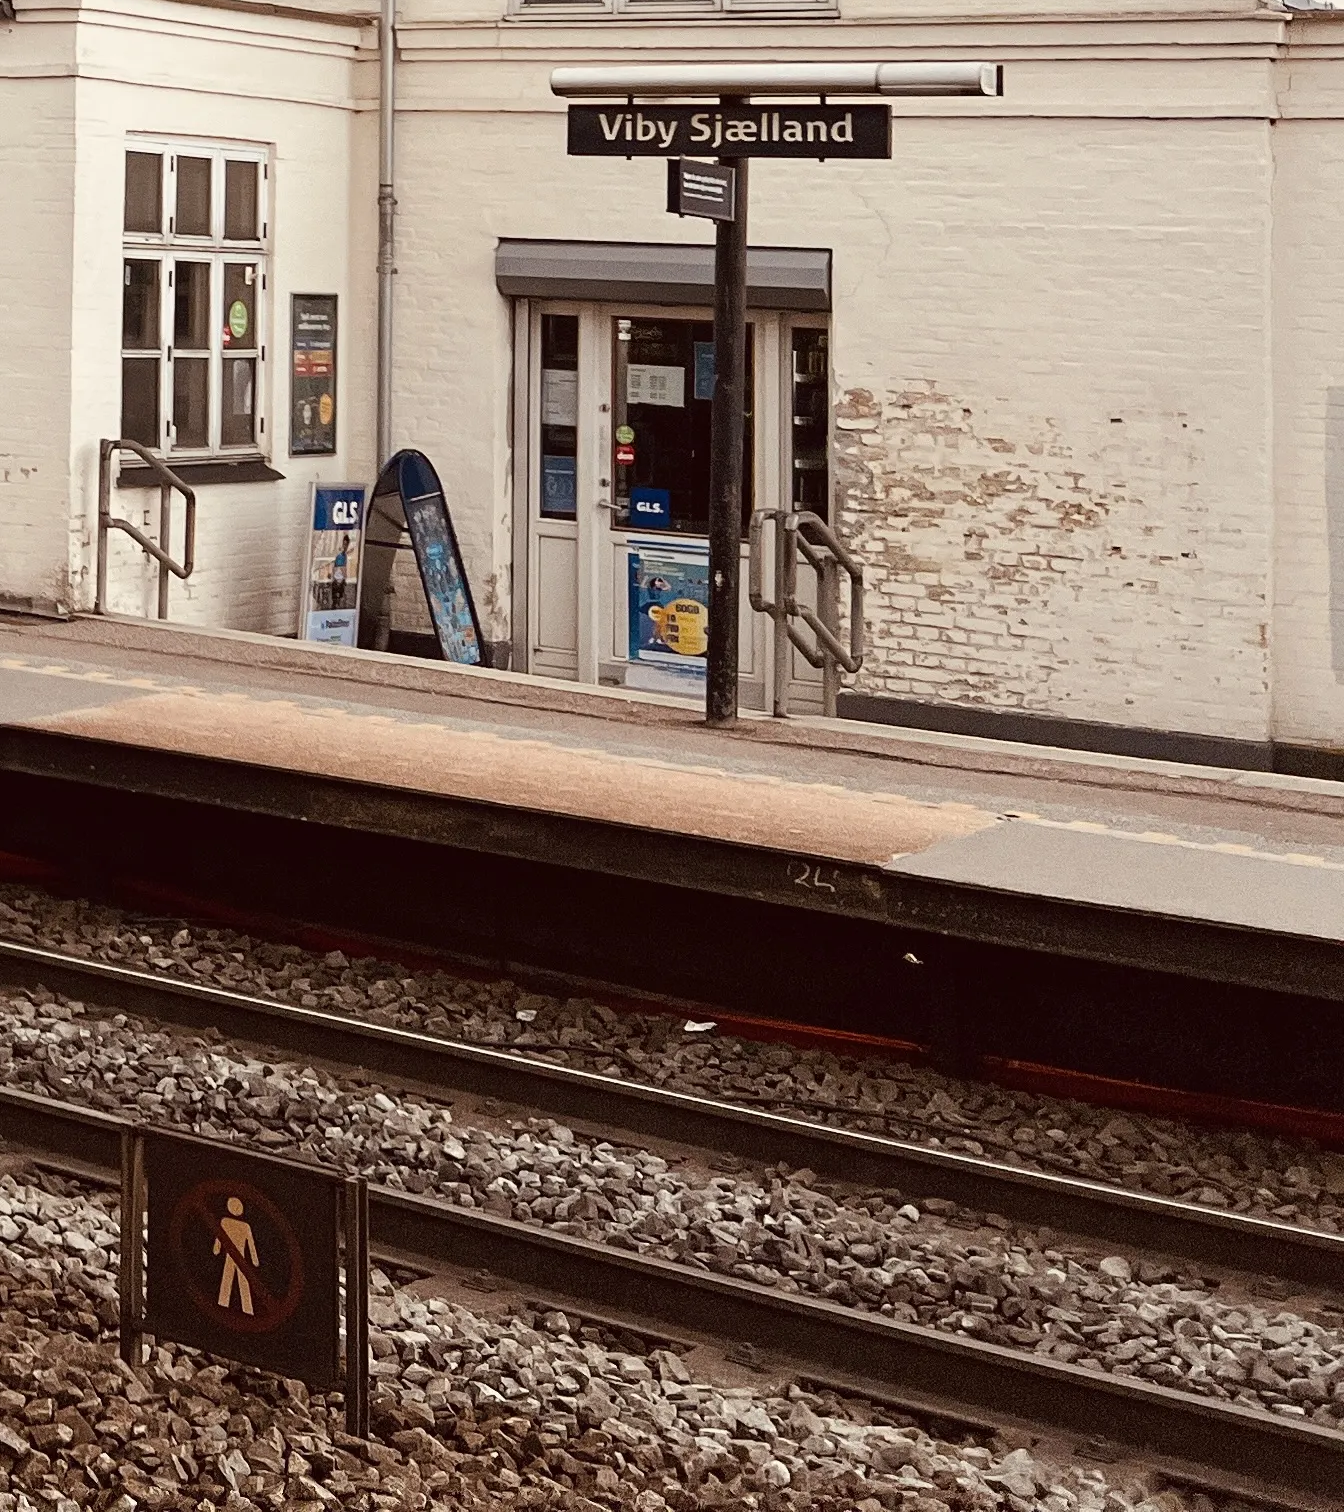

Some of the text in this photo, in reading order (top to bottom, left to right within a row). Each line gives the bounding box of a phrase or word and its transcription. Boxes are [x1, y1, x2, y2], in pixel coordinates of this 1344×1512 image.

[599, 112, 854, 148] Viby Sjælland
[332, 500, 358, 525] GLS
